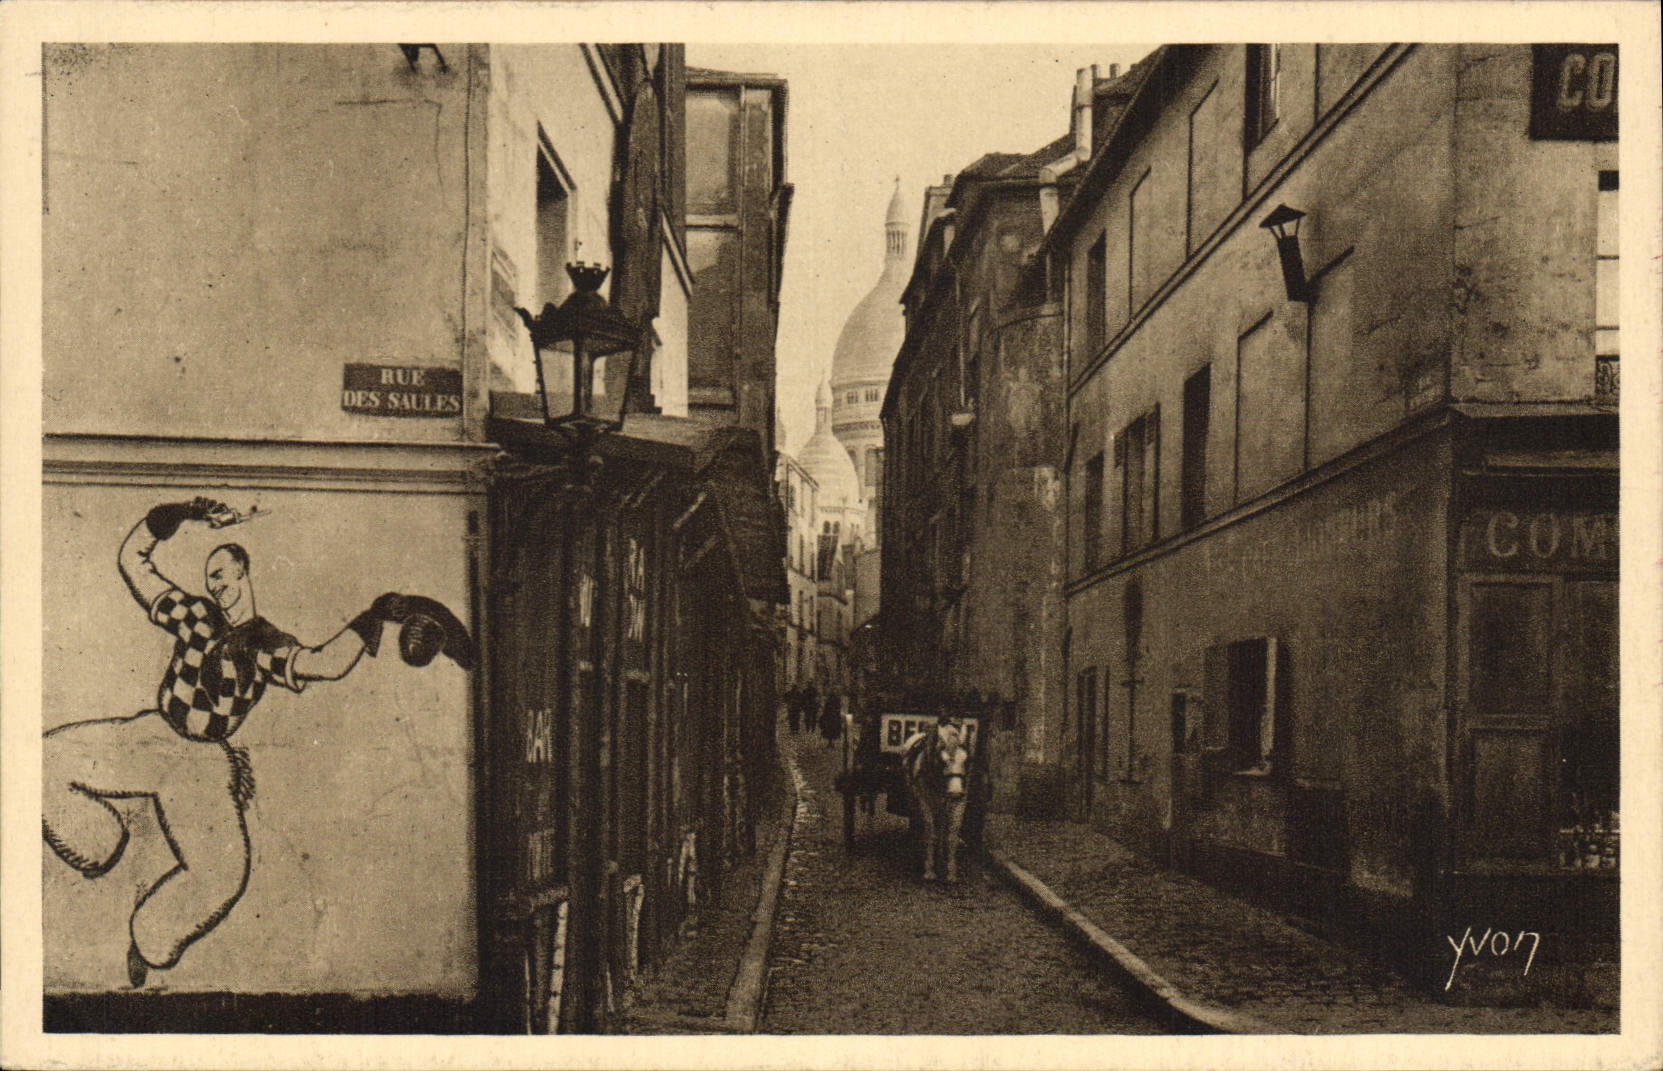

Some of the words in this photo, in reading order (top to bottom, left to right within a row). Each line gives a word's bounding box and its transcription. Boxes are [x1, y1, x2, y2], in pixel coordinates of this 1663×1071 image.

[1556, 52, 1617, 112] CO
[382, 368, 424, 386] RUE
[343, 389, 380, 407] DES
[387, 391, 460, 412] SAULES
[1486, 509, 1617, 560] COM
